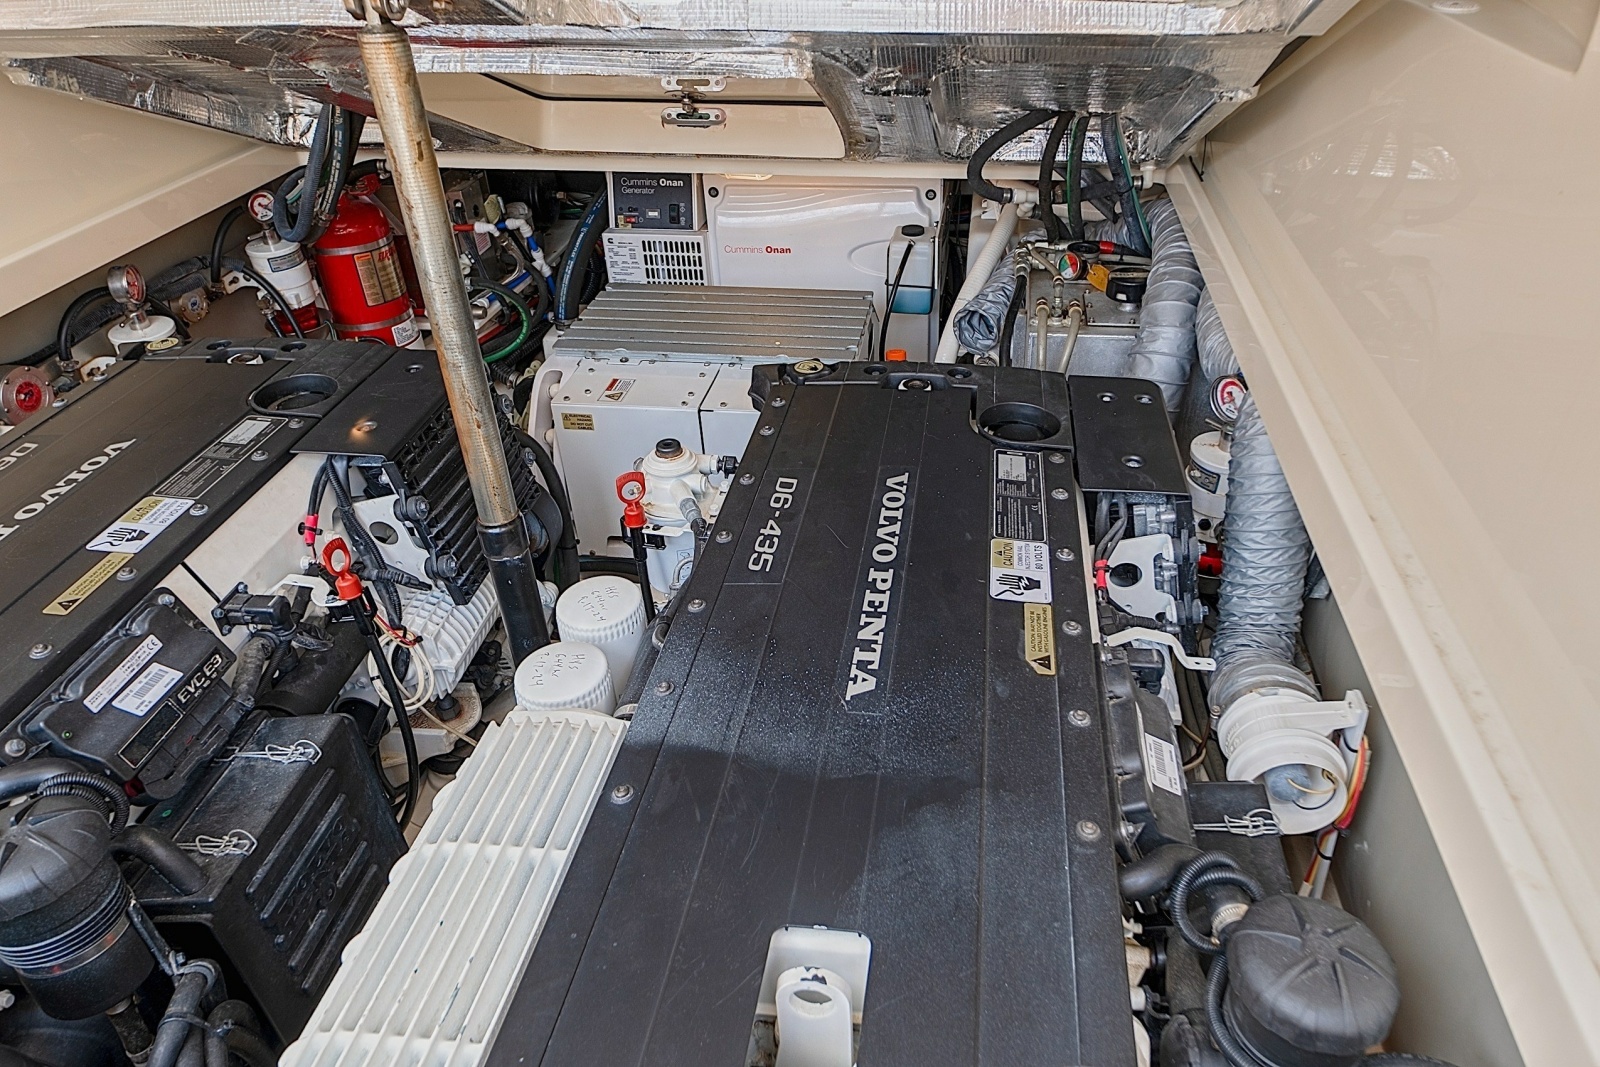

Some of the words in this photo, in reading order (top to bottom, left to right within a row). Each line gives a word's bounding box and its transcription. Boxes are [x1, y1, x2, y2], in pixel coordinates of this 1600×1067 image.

[620, 177, 658, 186] Cummins
[659, 178, 684, 187] Onan
[621, 186, 655, 194] Generator
[724, 244, 764, 254] Cummins
[765, 245, 792, 254] Onan
[13, 438, 137, 520] VOLVO
[132, 499, 163, 521] CAUTION
[166, 501, 189, 517] VOLTS
[871, 472, 909, 563] VOLVO
[747, 476, 798, 572] D6-435
[1003, 541, 1013, 566] CAUTION
[1033, 544, 1043, 562] VOLTS
[845, 567, 894, 701] PENTA
[177, 671, 206, 704] EVC
[203, 654, 222, 677] E3
